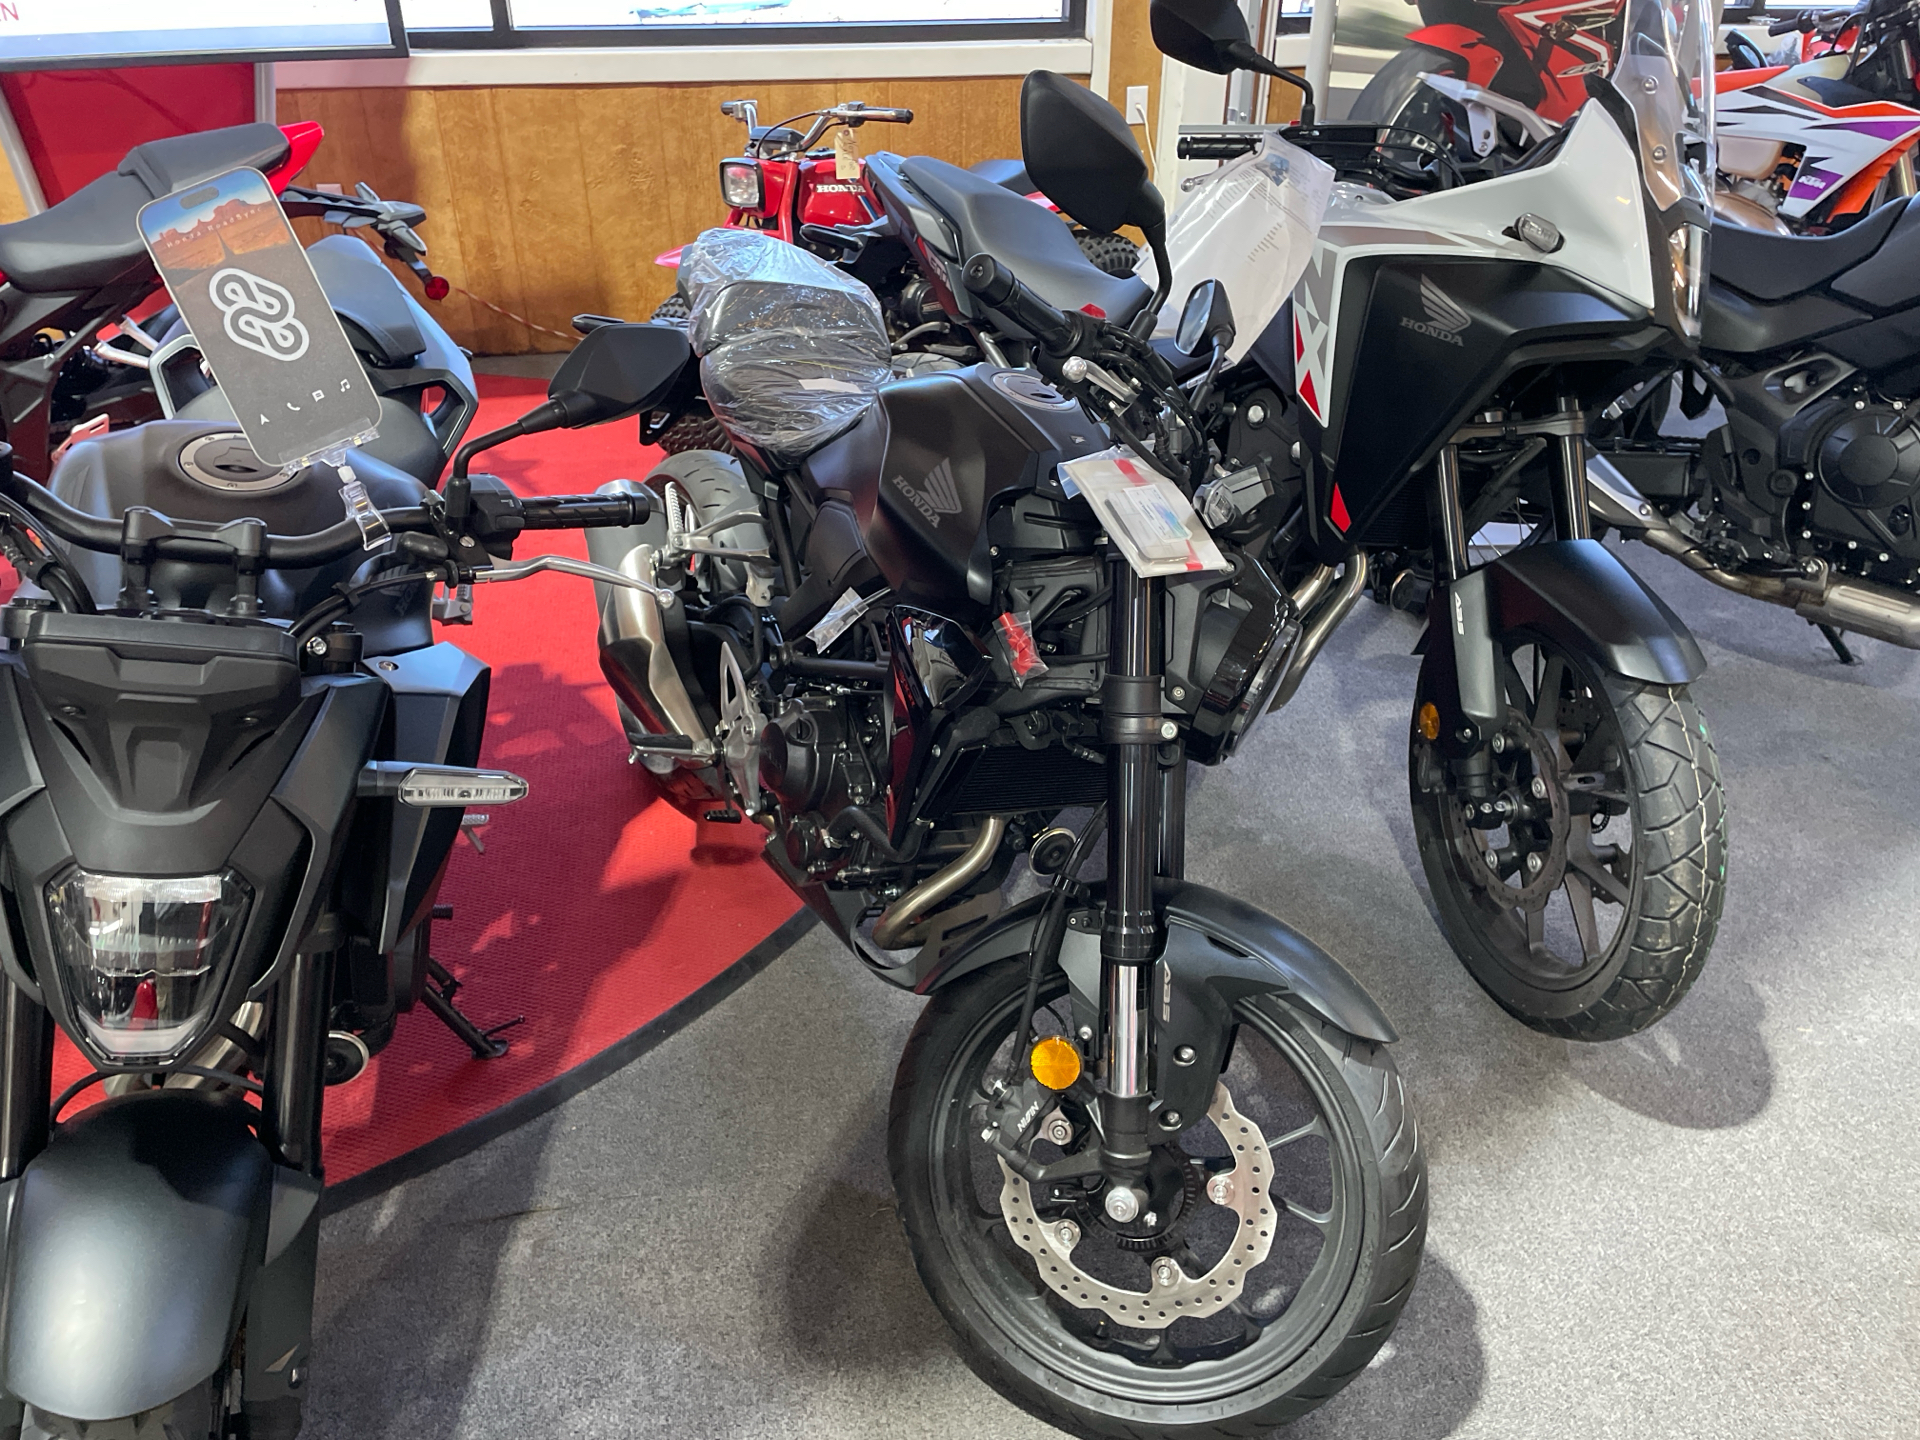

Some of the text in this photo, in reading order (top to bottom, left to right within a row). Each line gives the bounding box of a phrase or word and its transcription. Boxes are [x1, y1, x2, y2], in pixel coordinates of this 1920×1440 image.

[816, 184, 866, 193] HONDA
[1798, 174, 1827, 190] KTM
[1400, 316, 1465, 347] HONDA
[892, 474, 941, 529] HONDA
[1454, 591, 1465, 636] ABS
[1162, 960, 1172, 1023] ABS
